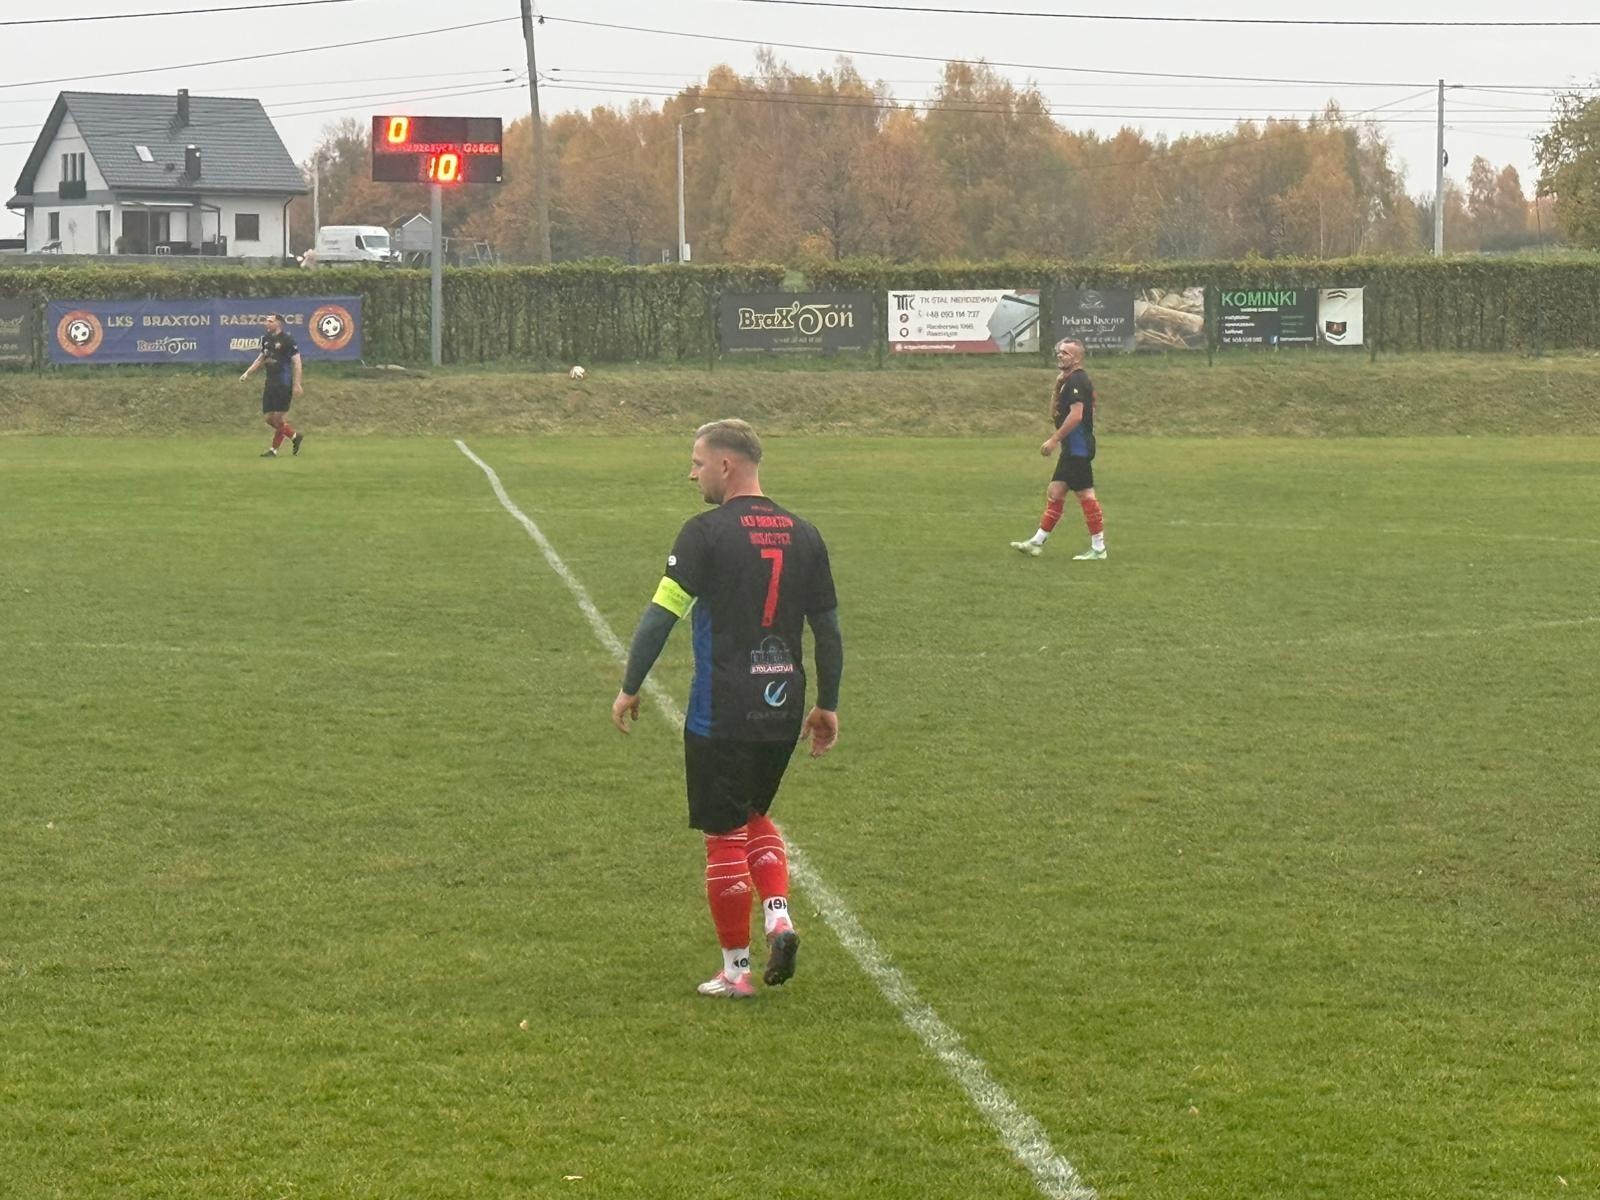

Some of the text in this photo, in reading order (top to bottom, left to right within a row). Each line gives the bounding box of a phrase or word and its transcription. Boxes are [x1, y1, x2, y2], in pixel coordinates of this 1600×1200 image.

[387, 116, 409, 144] 0
[1221, 291, 1297, 306] KOMINKI
[107, 313, 303, 327] LKS BRAXTON RASZCCE
[760, 548, 783, 627] 7
